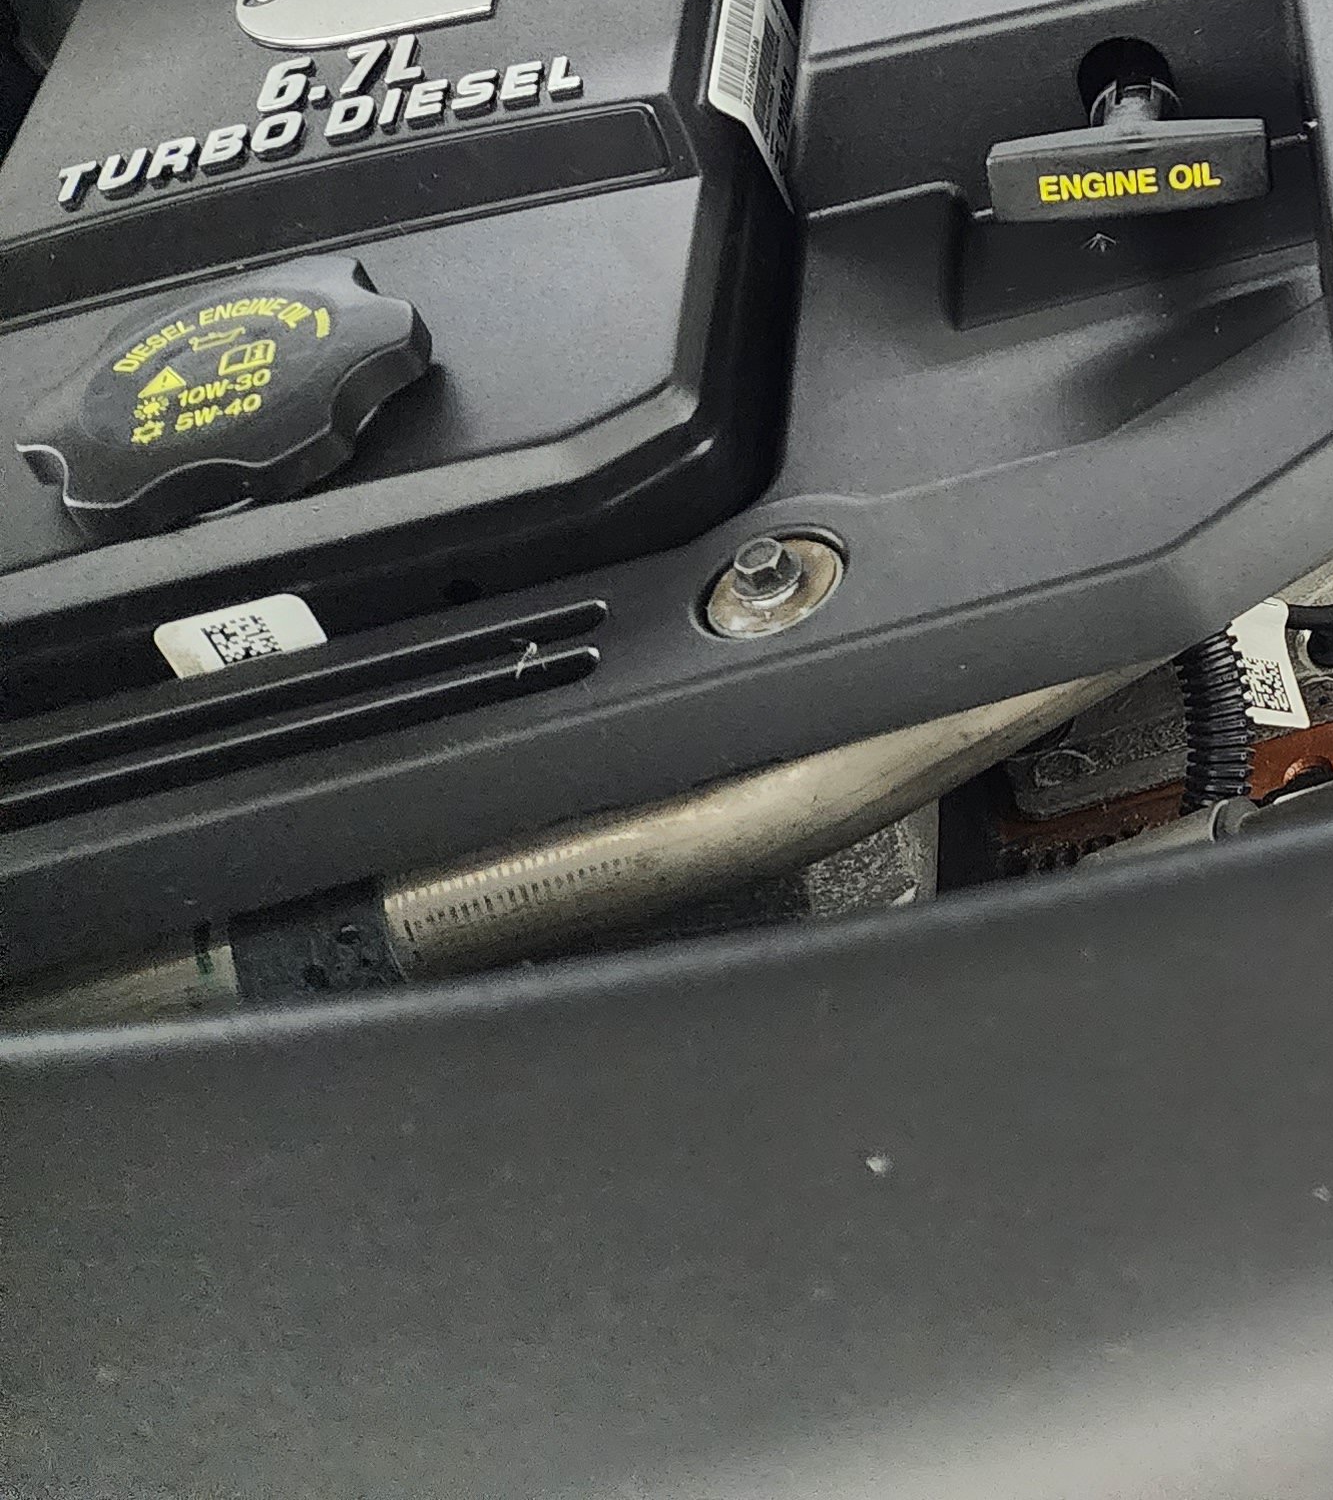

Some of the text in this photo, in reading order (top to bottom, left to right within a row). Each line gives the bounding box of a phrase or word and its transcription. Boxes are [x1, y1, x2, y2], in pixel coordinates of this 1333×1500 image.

[256, 33, 424, 115] 6.7L
[56, 56, 586, 212] TURBO DIESEL
[1038, 161, 1222, 202] ENGINE OIL
[112, 320, 196, 374] DIESEL
[199, 297, 288, 326] ENGINE
[277, 301, 313, 329] OIL
[174, 393, 263, 432] 5W-40
[177, 367, 272, 408] 10W-30
